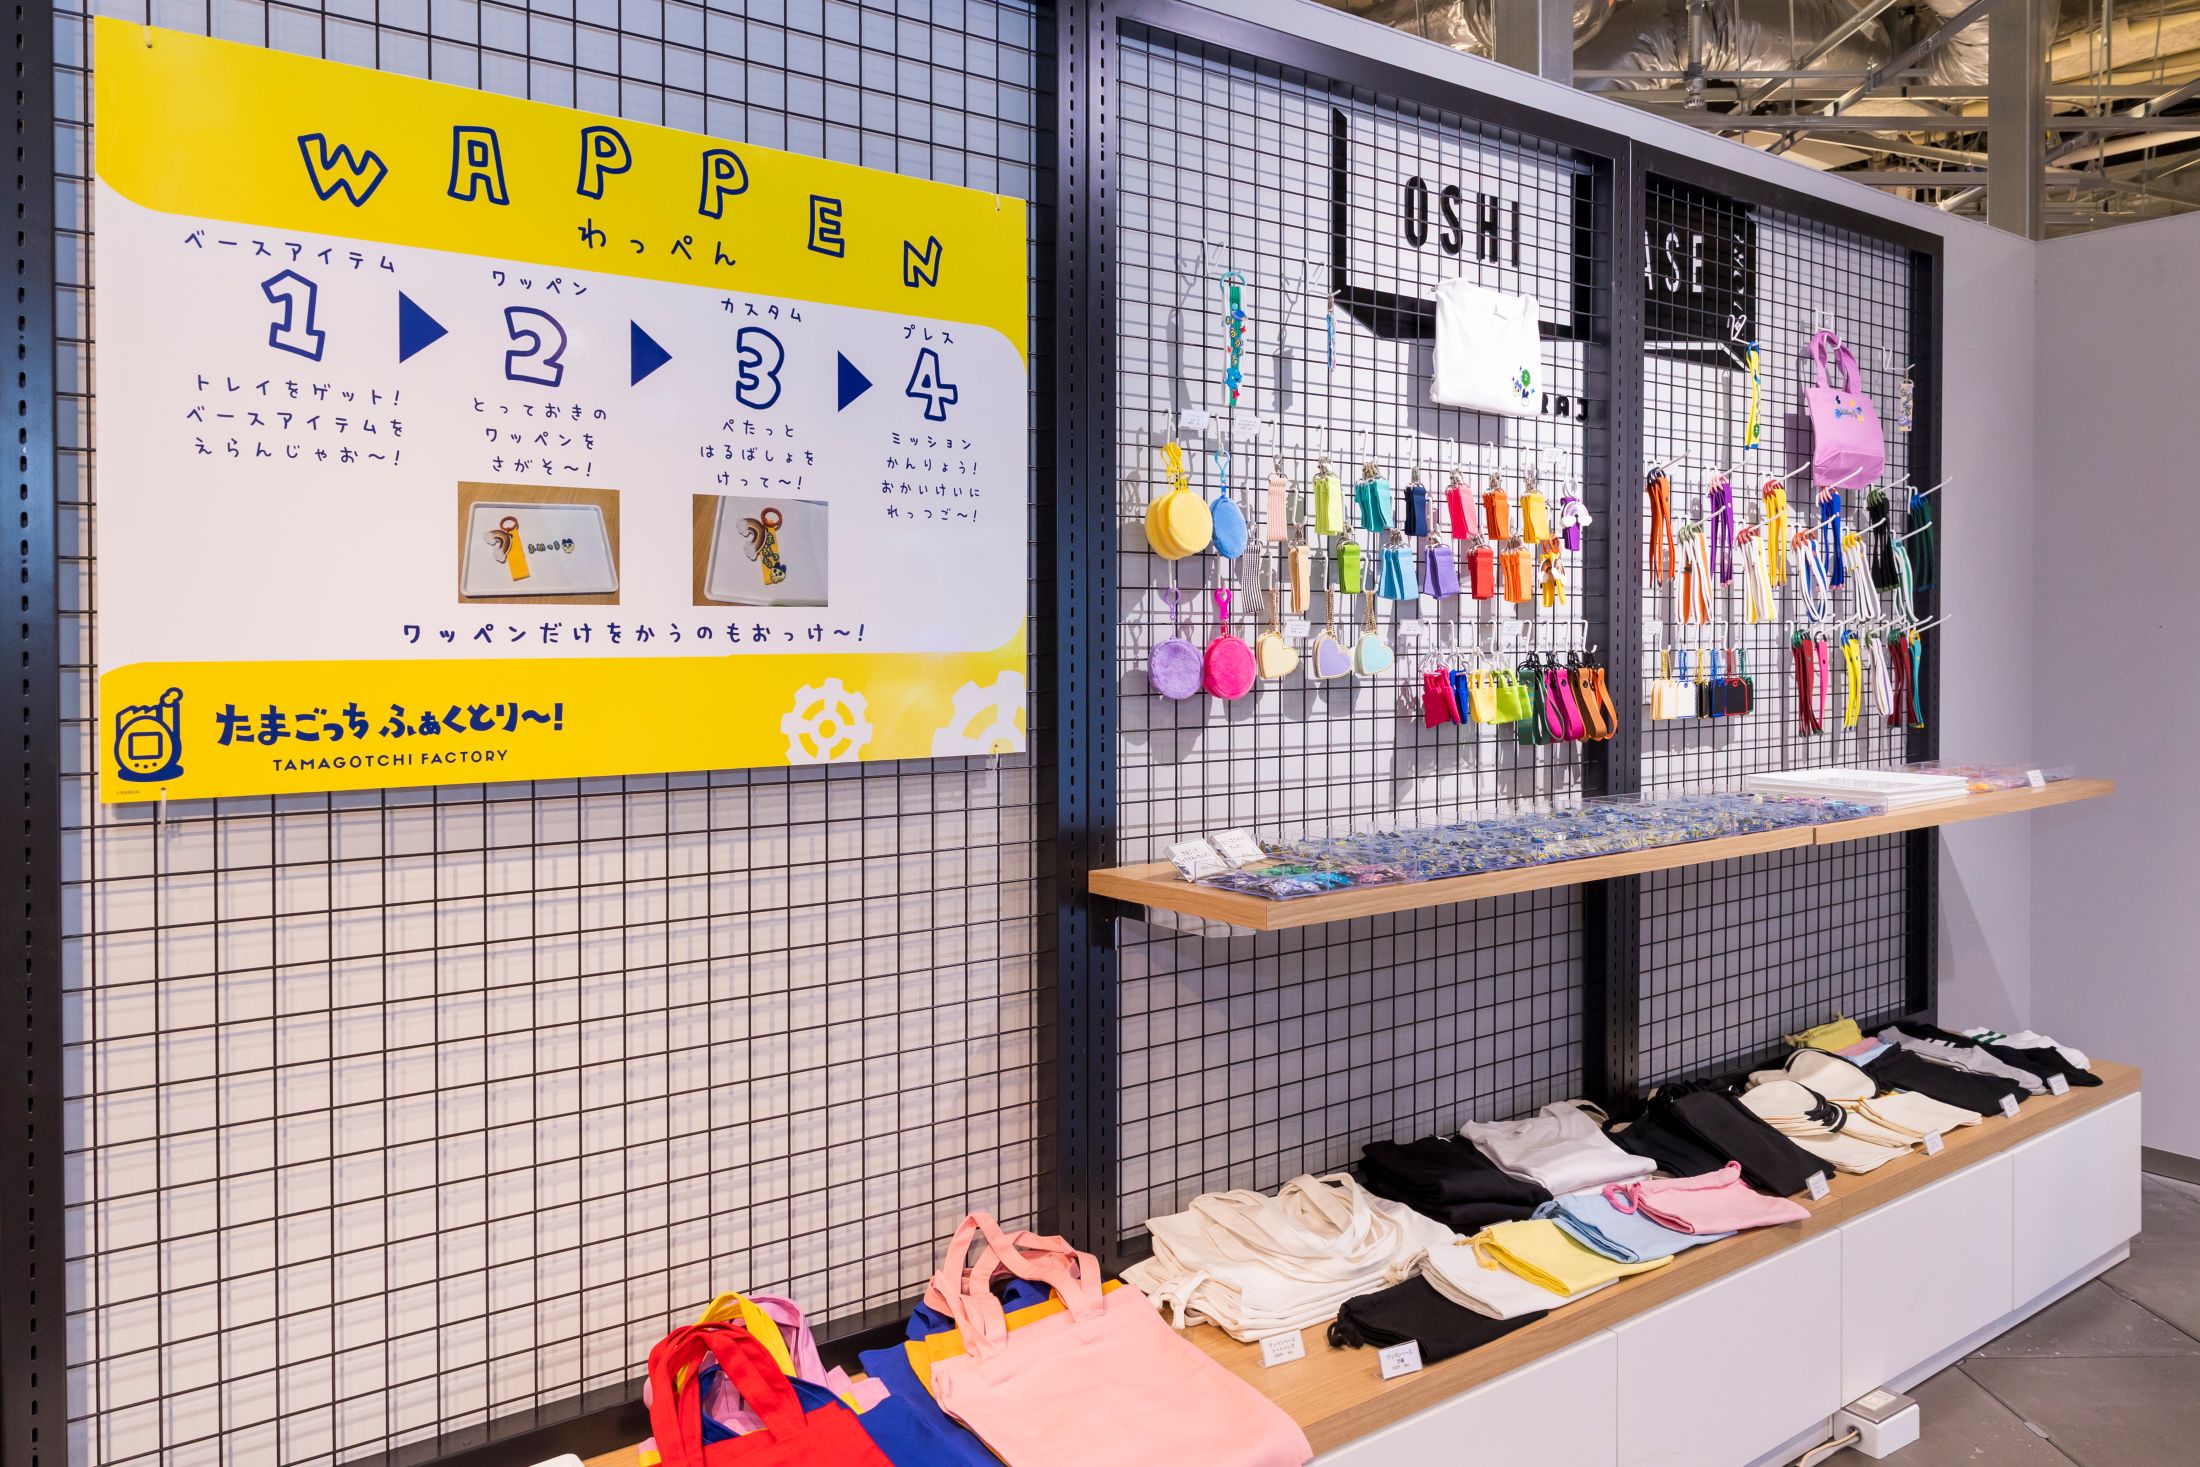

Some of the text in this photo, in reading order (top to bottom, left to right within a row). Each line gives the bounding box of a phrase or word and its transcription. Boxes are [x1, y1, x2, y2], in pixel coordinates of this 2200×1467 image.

[297, 125, 943, 288] WAPPEN
[577, 219, 737, 266] わっぺん
[1404, 175, 1704, 293] OSHI ASE
[184, 229, 395, 273] ベースアイテム
[492, 270, 587, 296] ワッペン
[260, 268, 326, 363] 1
[720, 297, 802, 323] カスタム
[503, 305, 568, 388] 2
[903, 323, 954, 345] プレス
[735, 326, 785, 411] 3
[197, 374, 400, 406] トレイをゲット!
[904, 346, 959, 423] 4
[186, 405, 402, 437] ベースアイテムを
[473, 397, 607, 422] とっておきの
[485, 428, 594, 450] ワッペンを
[722, 418, 794, 438] ぺたっと
[891, 432, 972, 450] ミッション
[700, 444, 814, 466] はるばしょを
[886, 456, 977, 475] かんりょう!
[881, 479, 980, 498] おかいけいに
[215, 702, 369, 747] たまごっち
[272, 749, 508, 772] TAMAGOTCHI FACTORY
